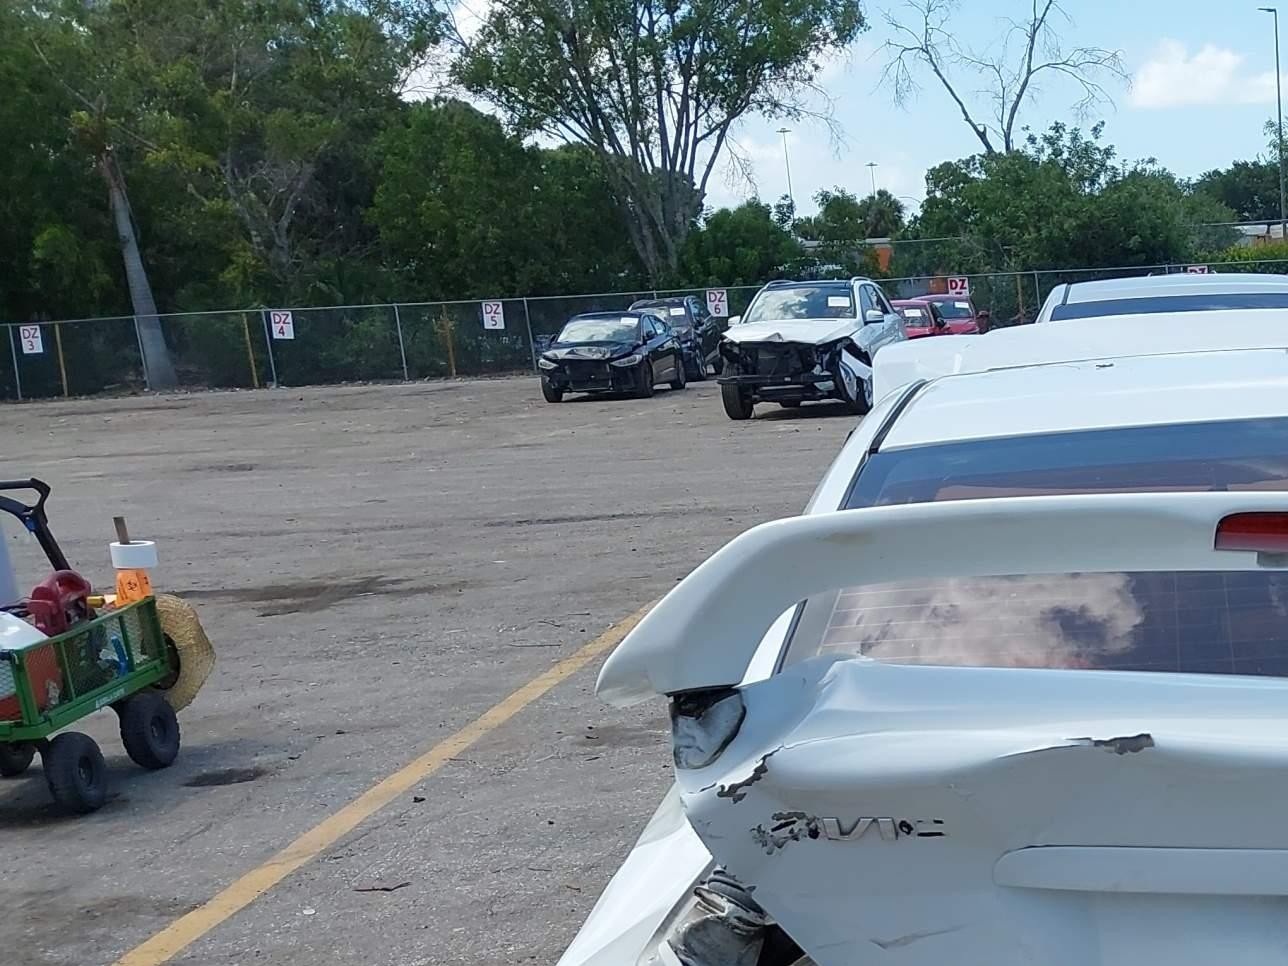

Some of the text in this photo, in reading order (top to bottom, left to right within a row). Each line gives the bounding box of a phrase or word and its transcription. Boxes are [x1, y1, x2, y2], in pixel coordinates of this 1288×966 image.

[949, 279, 967, 290] DZ
[708, 292, 725, 303] DZ
[485, 303, 501, 315] DZ
[714, 304, 721, 314] 6
[273, 313, 290, 325] DZ
[490, 316, 498, 327] 5
[22, 327, 39, 339] DZ
[278, 327, 285, 336] 4
[28, 340, 35, 350] 3
